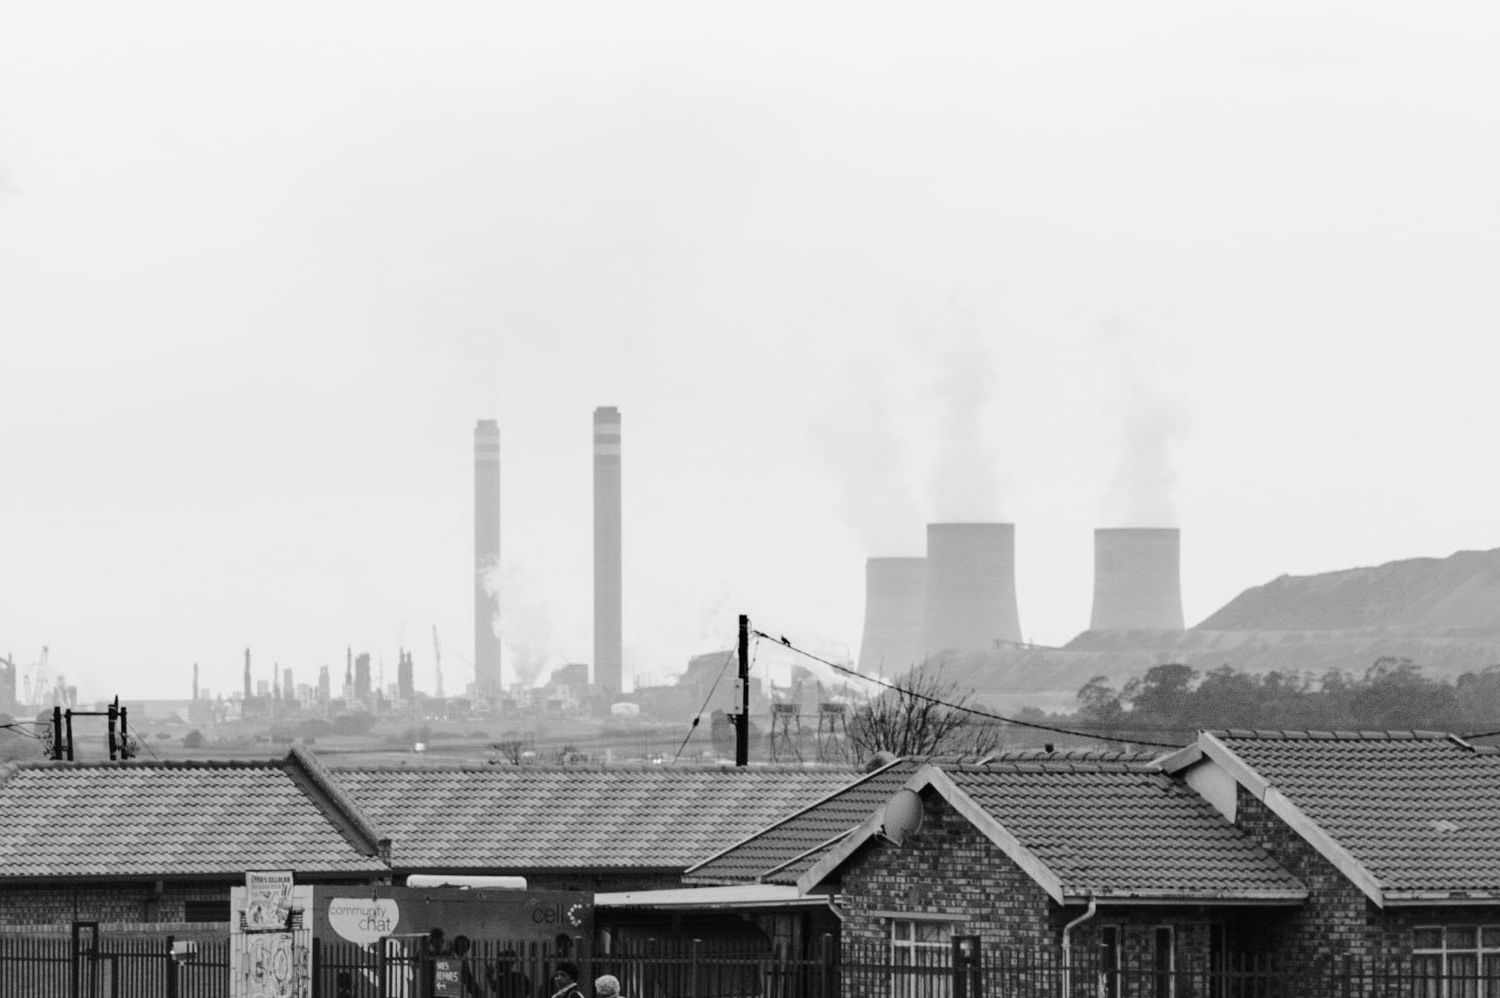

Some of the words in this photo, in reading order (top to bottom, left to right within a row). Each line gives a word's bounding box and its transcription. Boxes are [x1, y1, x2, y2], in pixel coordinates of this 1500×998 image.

[330, 906, 386, 917] community
[532, 904, 564, 923] cell
[358, 916, 390, 932] chat
